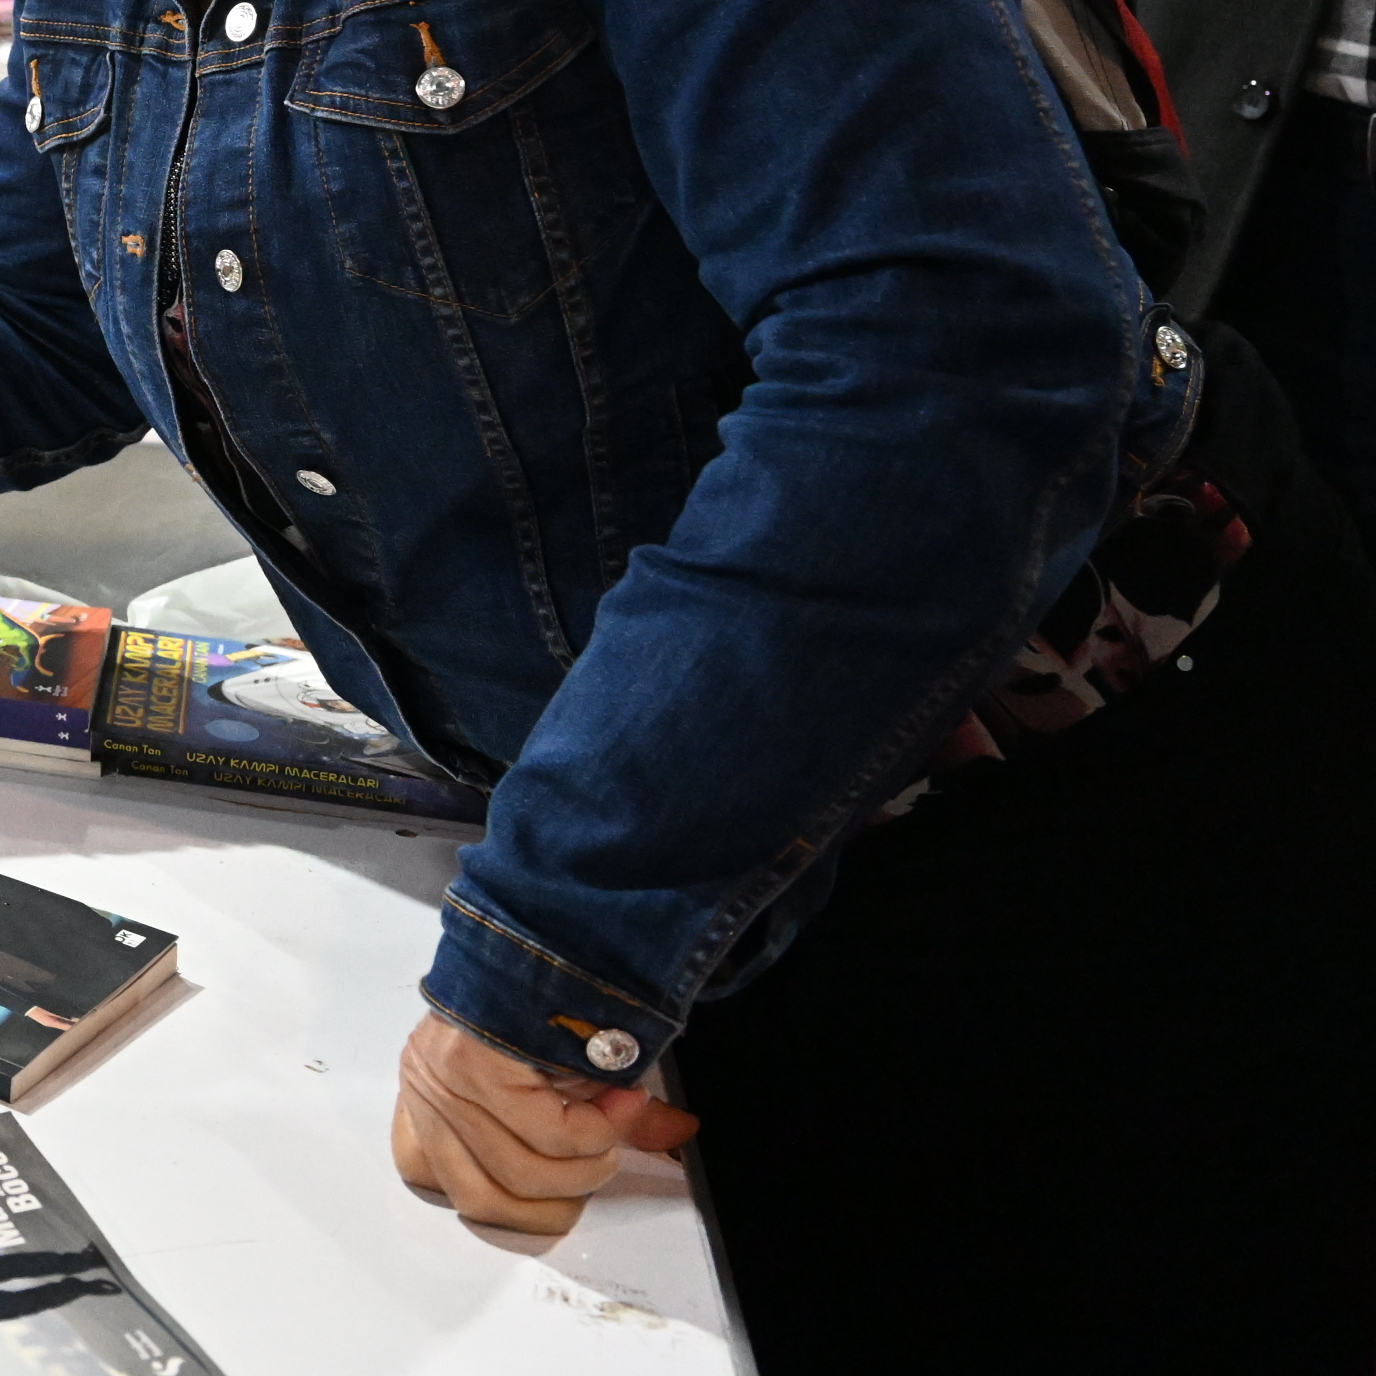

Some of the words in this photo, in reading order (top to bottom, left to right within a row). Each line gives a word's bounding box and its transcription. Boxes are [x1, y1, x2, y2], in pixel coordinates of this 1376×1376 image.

[124, 630, 155, 685] KAMPI
[113, 680, 148, 727] UZAY
[147, 635, 186, 733] MACERALARI
[104, 740, 140, 754] Canan
[142, 745, 162, 756] Tan
[186, 752, 226, 767] UZAY
[230, 758, 279, 774] KAMPI
[285, 766, 380, 789] MACERALARI
[132, 760, 166, 773] Canan
[170, 766, 189, 776] Tan
[214, 772, 252, 786] UZAY
